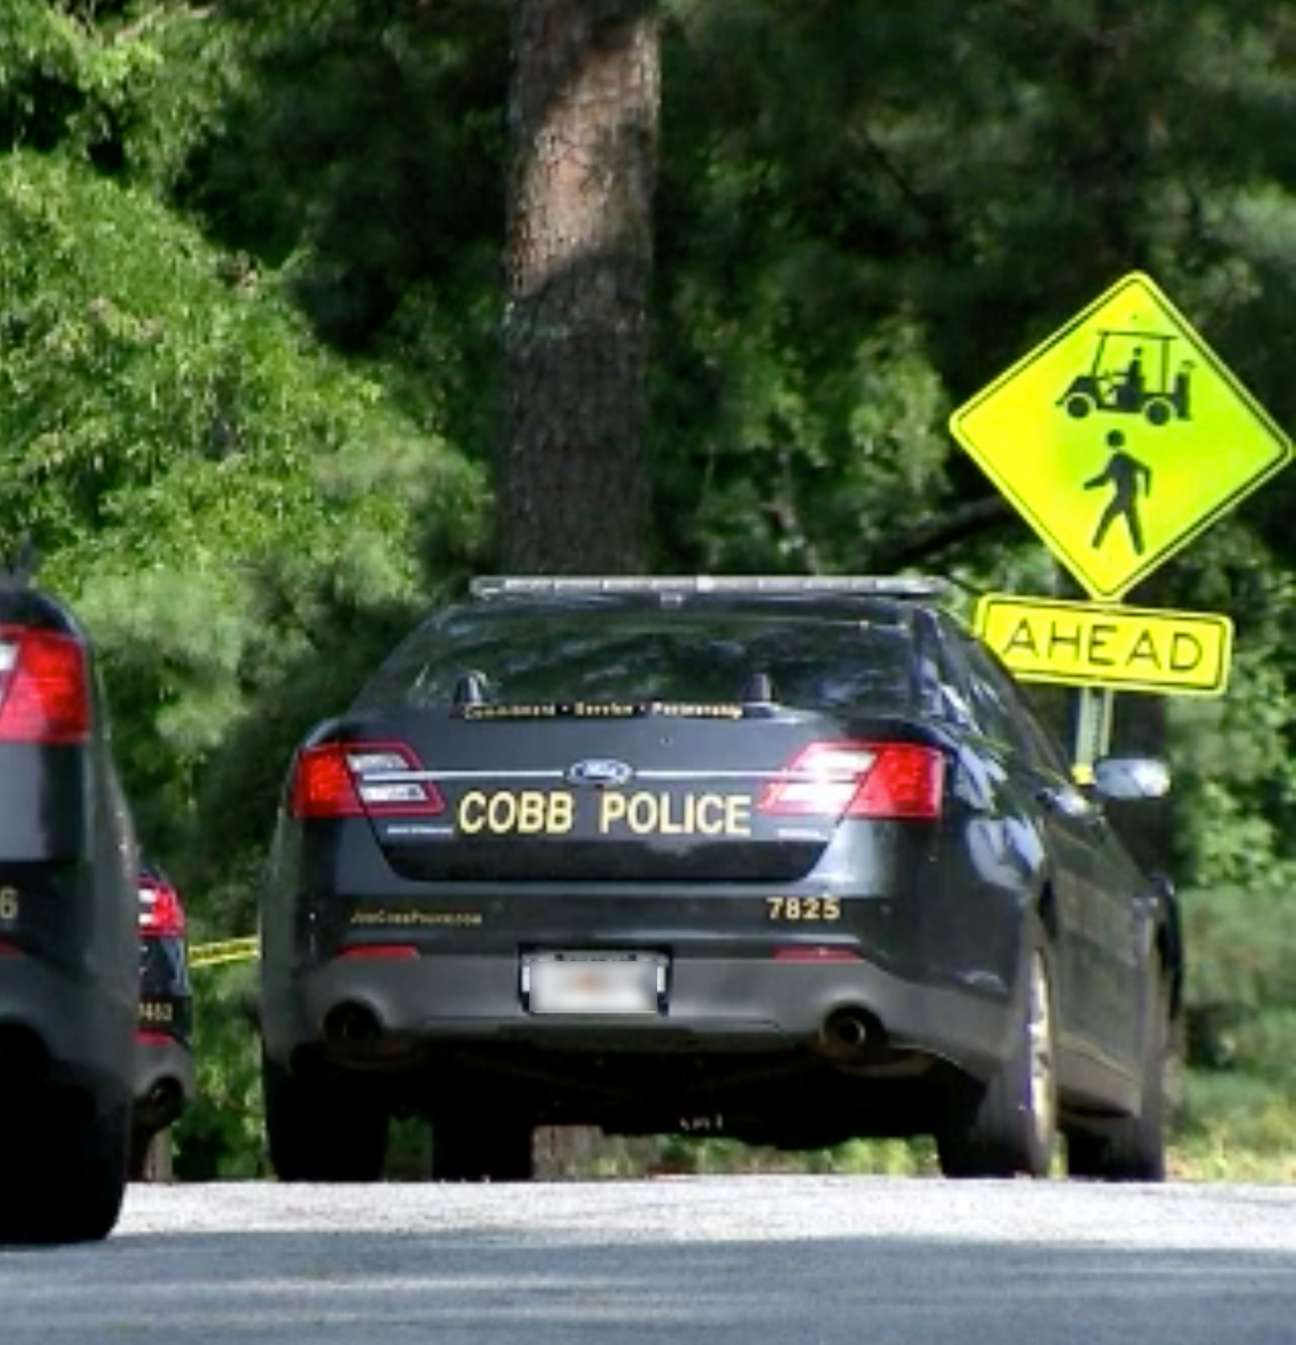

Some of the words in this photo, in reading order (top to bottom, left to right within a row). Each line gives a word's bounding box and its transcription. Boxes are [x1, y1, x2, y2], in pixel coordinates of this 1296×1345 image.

[1003, 617, 1202, 671] AHEAD
[459, 791, 574, 834] COBB
[599, 791, 752, 837] POLICE
[766, 896, 841, 920] 7825
